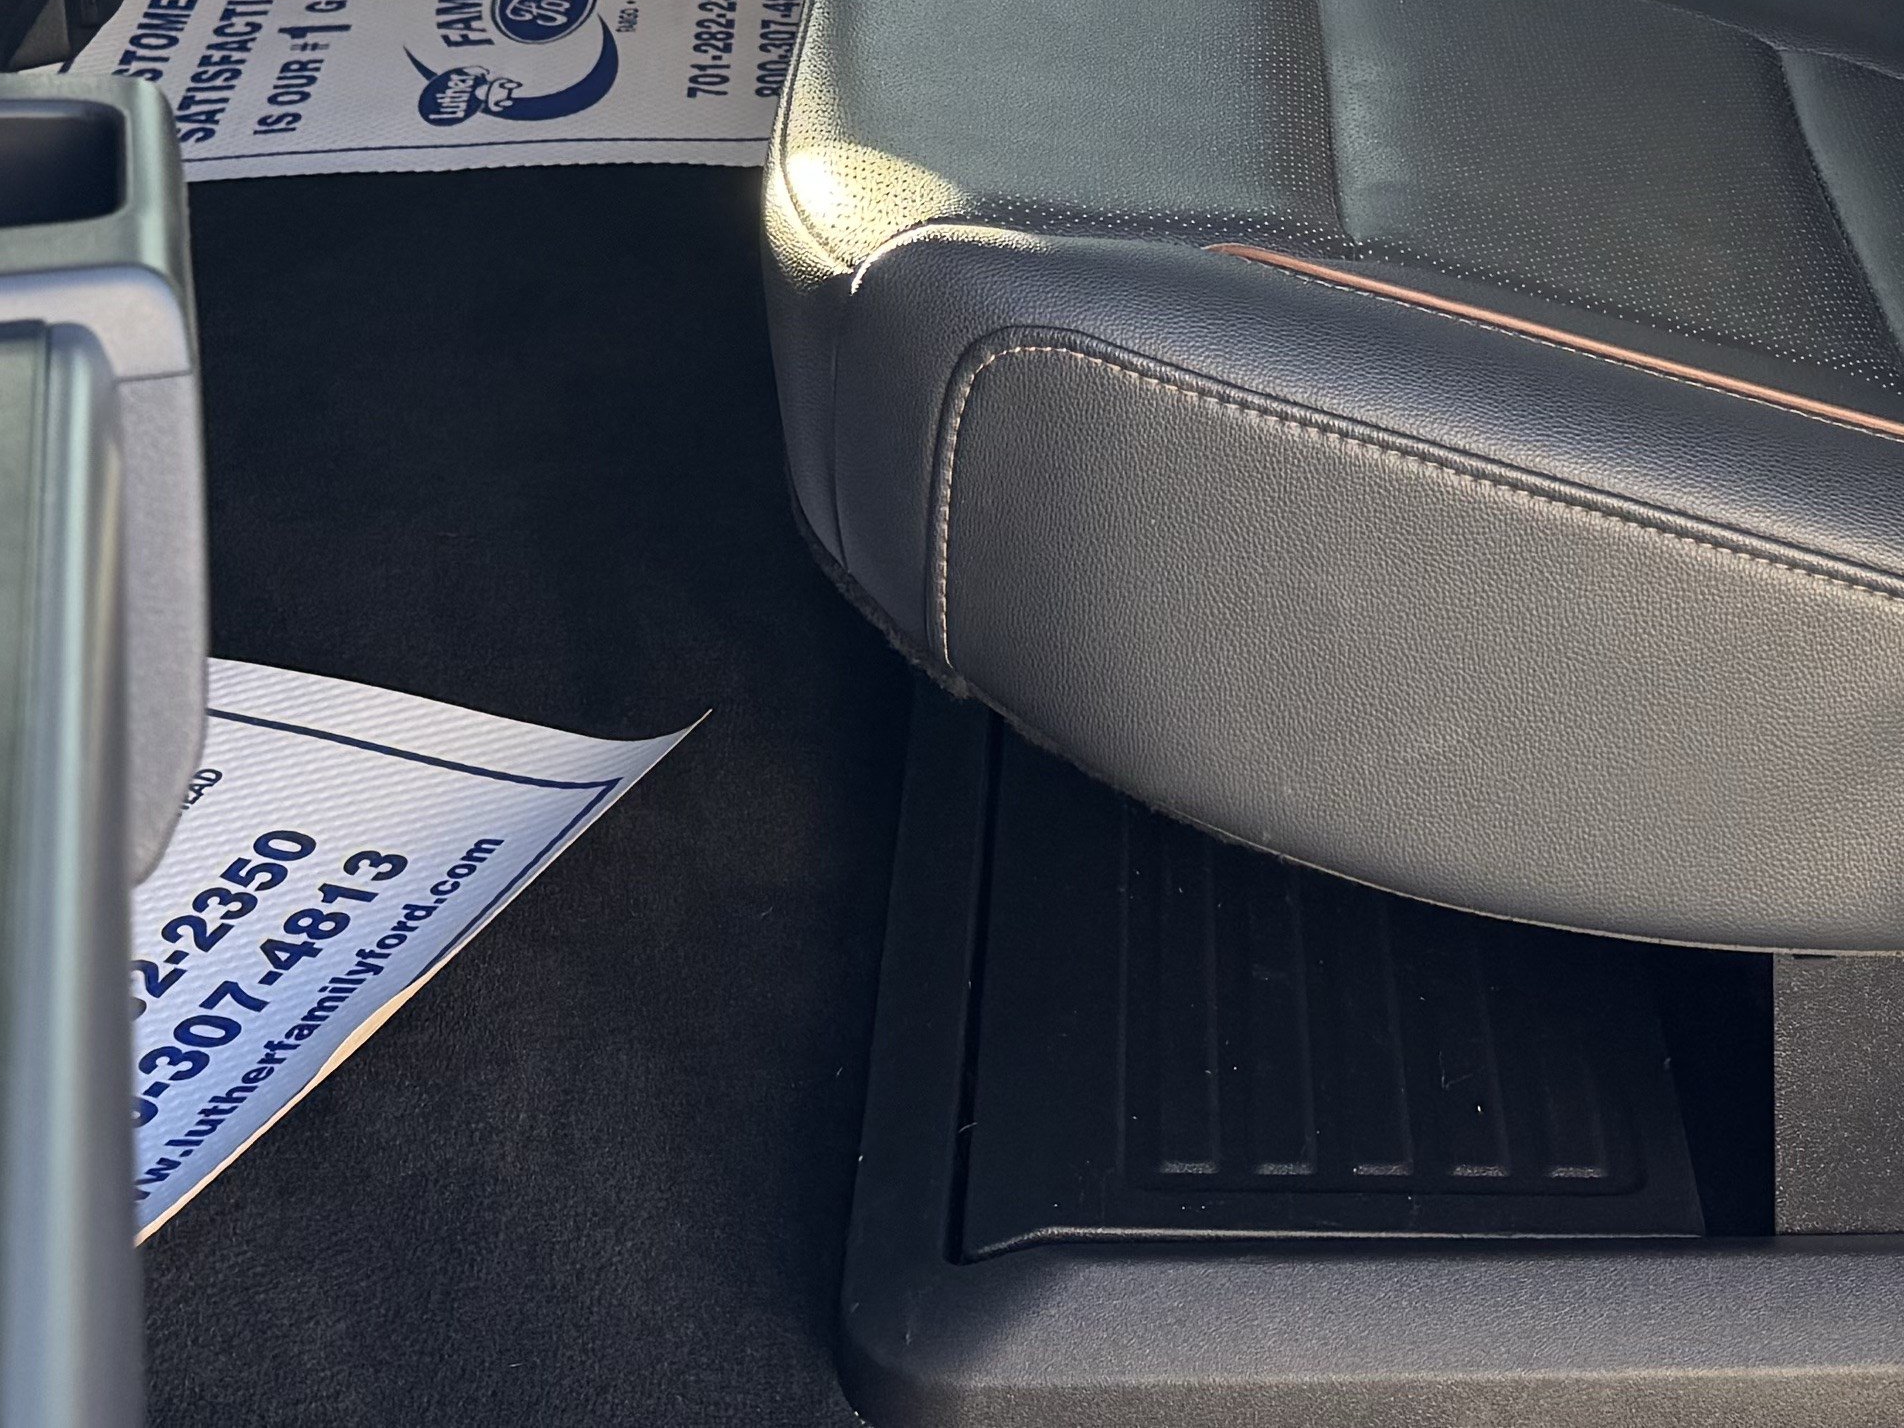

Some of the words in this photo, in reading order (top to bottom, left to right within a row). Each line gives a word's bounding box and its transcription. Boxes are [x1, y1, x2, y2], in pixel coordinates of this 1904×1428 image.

[266, 58, 325, 107] OUR
[428, 72, 476, 120] Luther
[253, 111, 302, 136] IS
